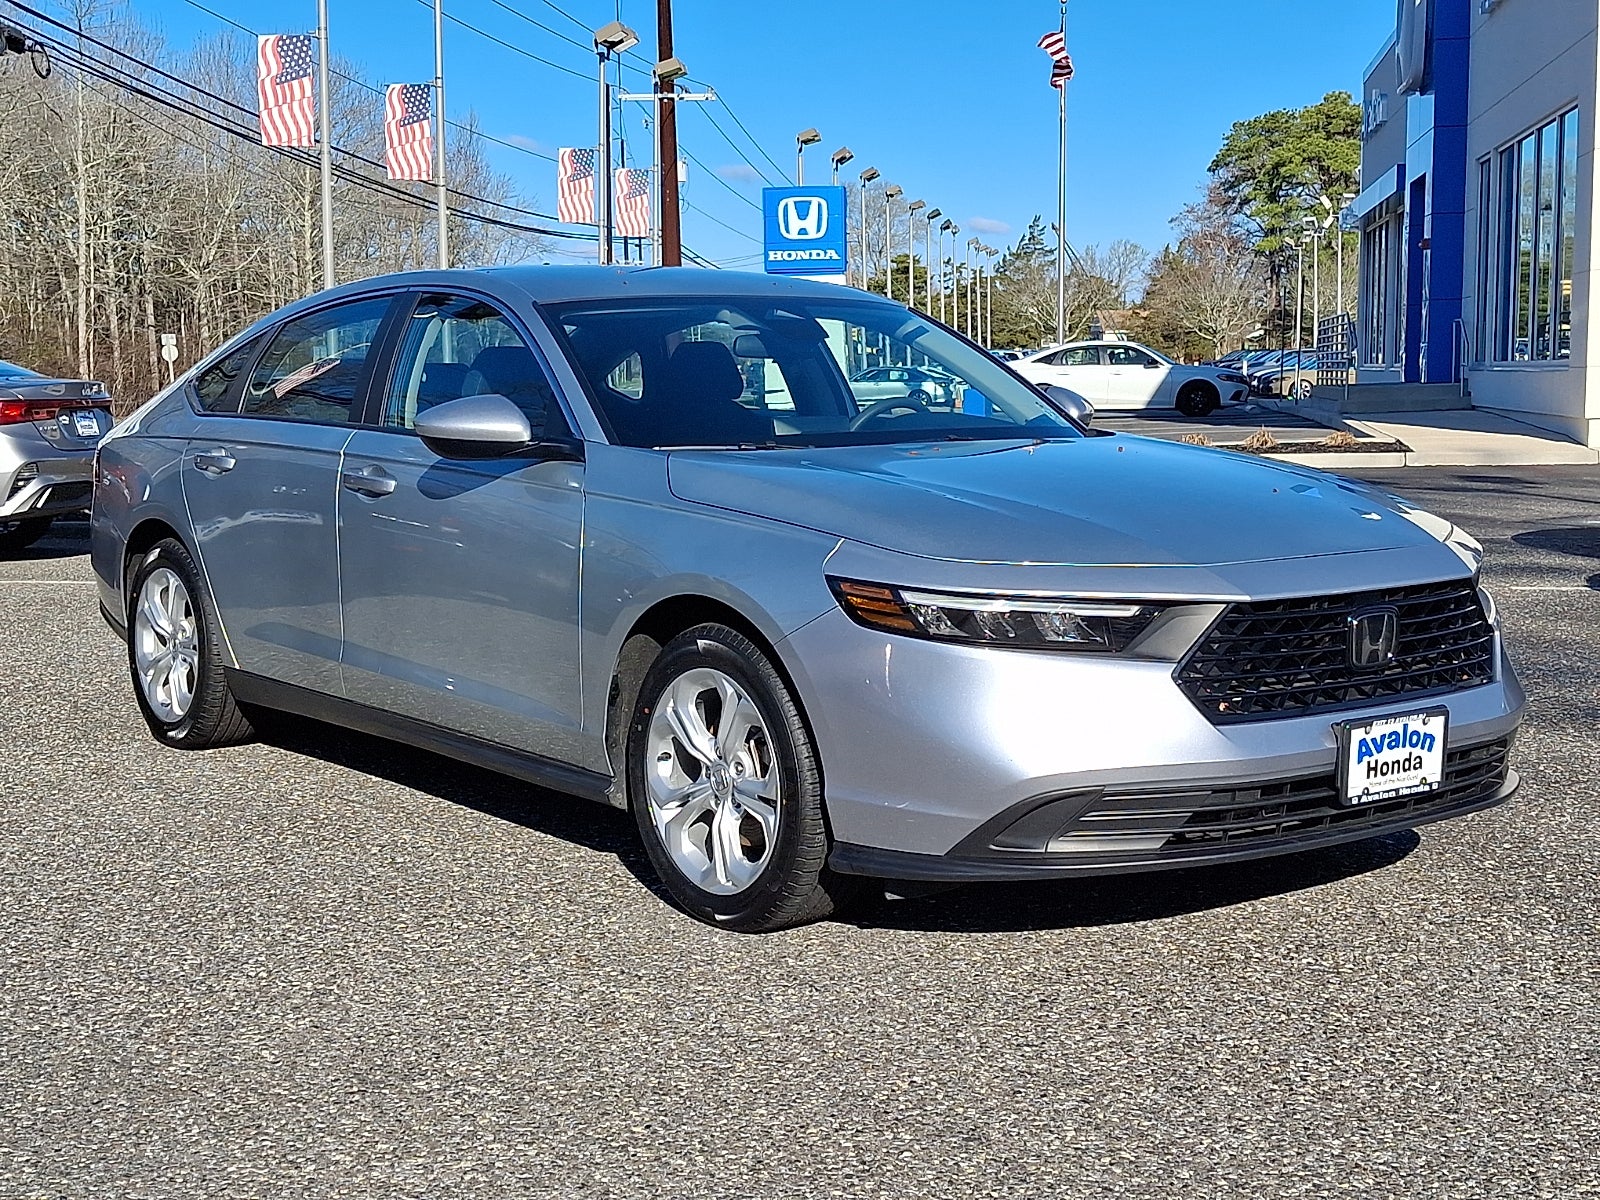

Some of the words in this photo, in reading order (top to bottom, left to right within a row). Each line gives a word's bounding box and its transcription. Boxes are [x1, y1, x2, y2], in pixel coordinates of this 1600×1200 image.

[768, 249, 841, 261] HONDA
[1357, 723, 1436, 765] Avalon
[1366, 751, 1423, 779] Honda
[1360, 789, 1396, 803] Avalon
[1399, 783, 1430, 796] Honda
